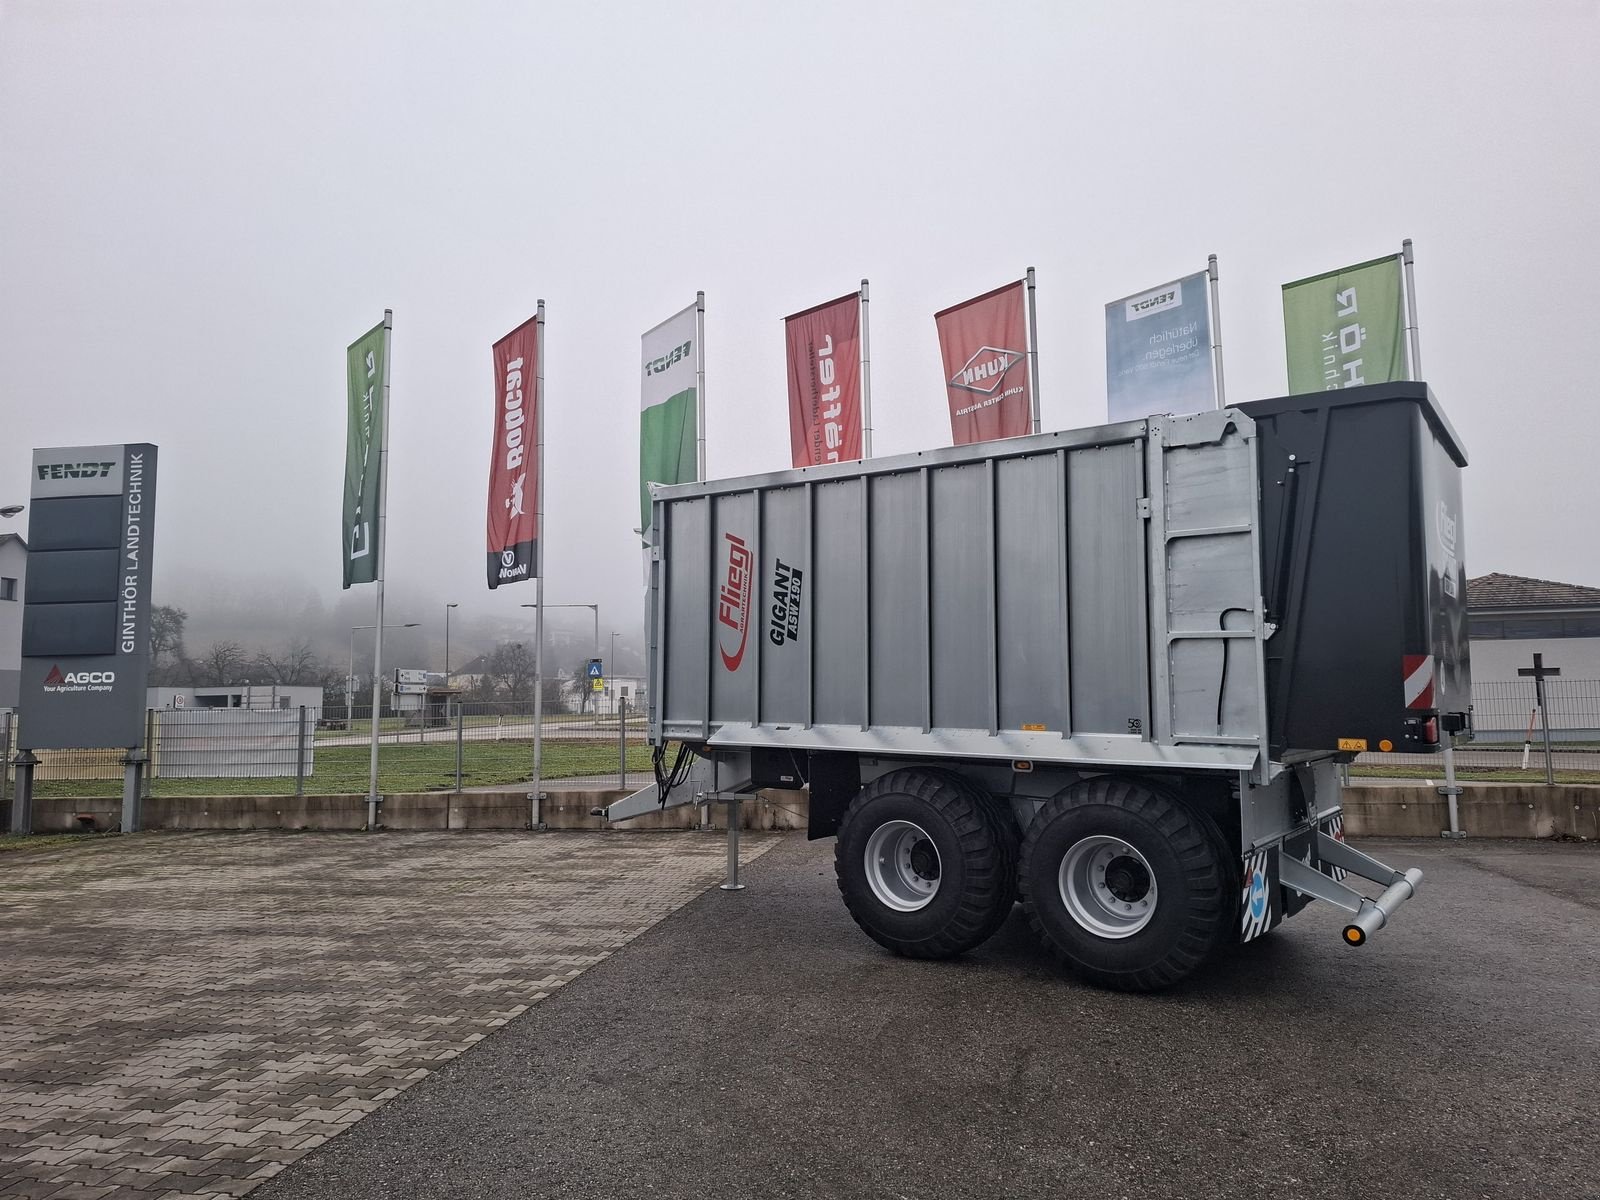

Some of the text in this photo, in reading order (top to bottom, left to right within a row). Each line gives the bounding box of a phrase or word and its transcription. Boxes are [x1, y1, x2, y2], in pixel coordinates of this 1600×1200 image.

[37, 461, 117, 481] FENDT
[121, 453, 143, 653] GINTHÖR LANDTECHNIK
[719, 532, 750, 631] Fliegl
[739, 573, 749, 633] AGRARTECHNIK
[770, 558, 791, 647] GIGANT
[788, 577, 802, 635] ASW 190
[56, 685, 86, 693] Agriculture
[87, 684, 113, 693] Company
[64, 671, 115, 684] AGCO
